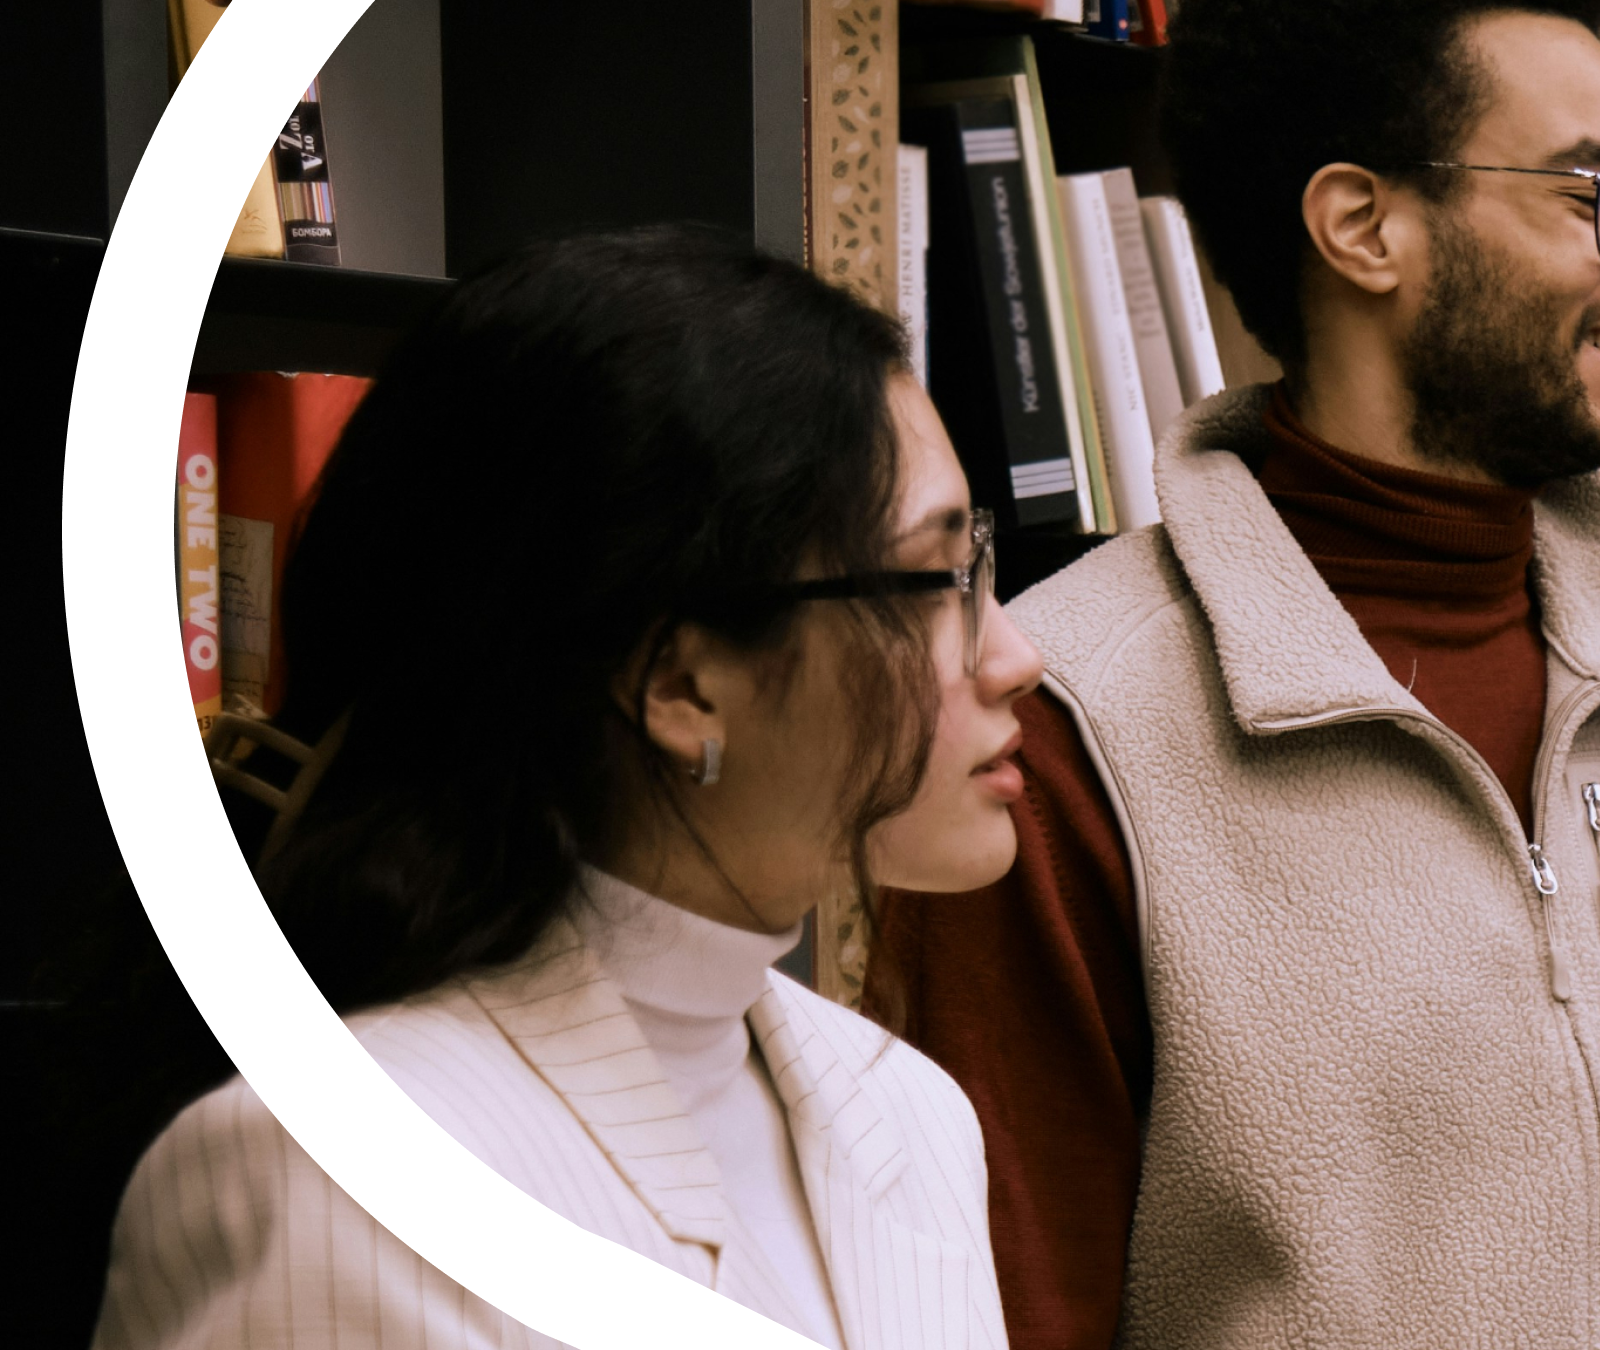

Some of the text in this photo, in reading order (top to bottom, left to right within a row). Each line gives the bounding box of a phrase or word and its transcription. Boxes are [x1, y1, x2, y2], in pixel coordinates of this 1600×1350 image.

[291, 227, 332, 238] БОМБОРА
[902, 166, 912, 236] MATISSE
[902, 242, 914, 297] HENRI
[991, 176, 1040, 413] Künstler der Sowjetunion
[185, 454, 219, 671] ONE TWO
